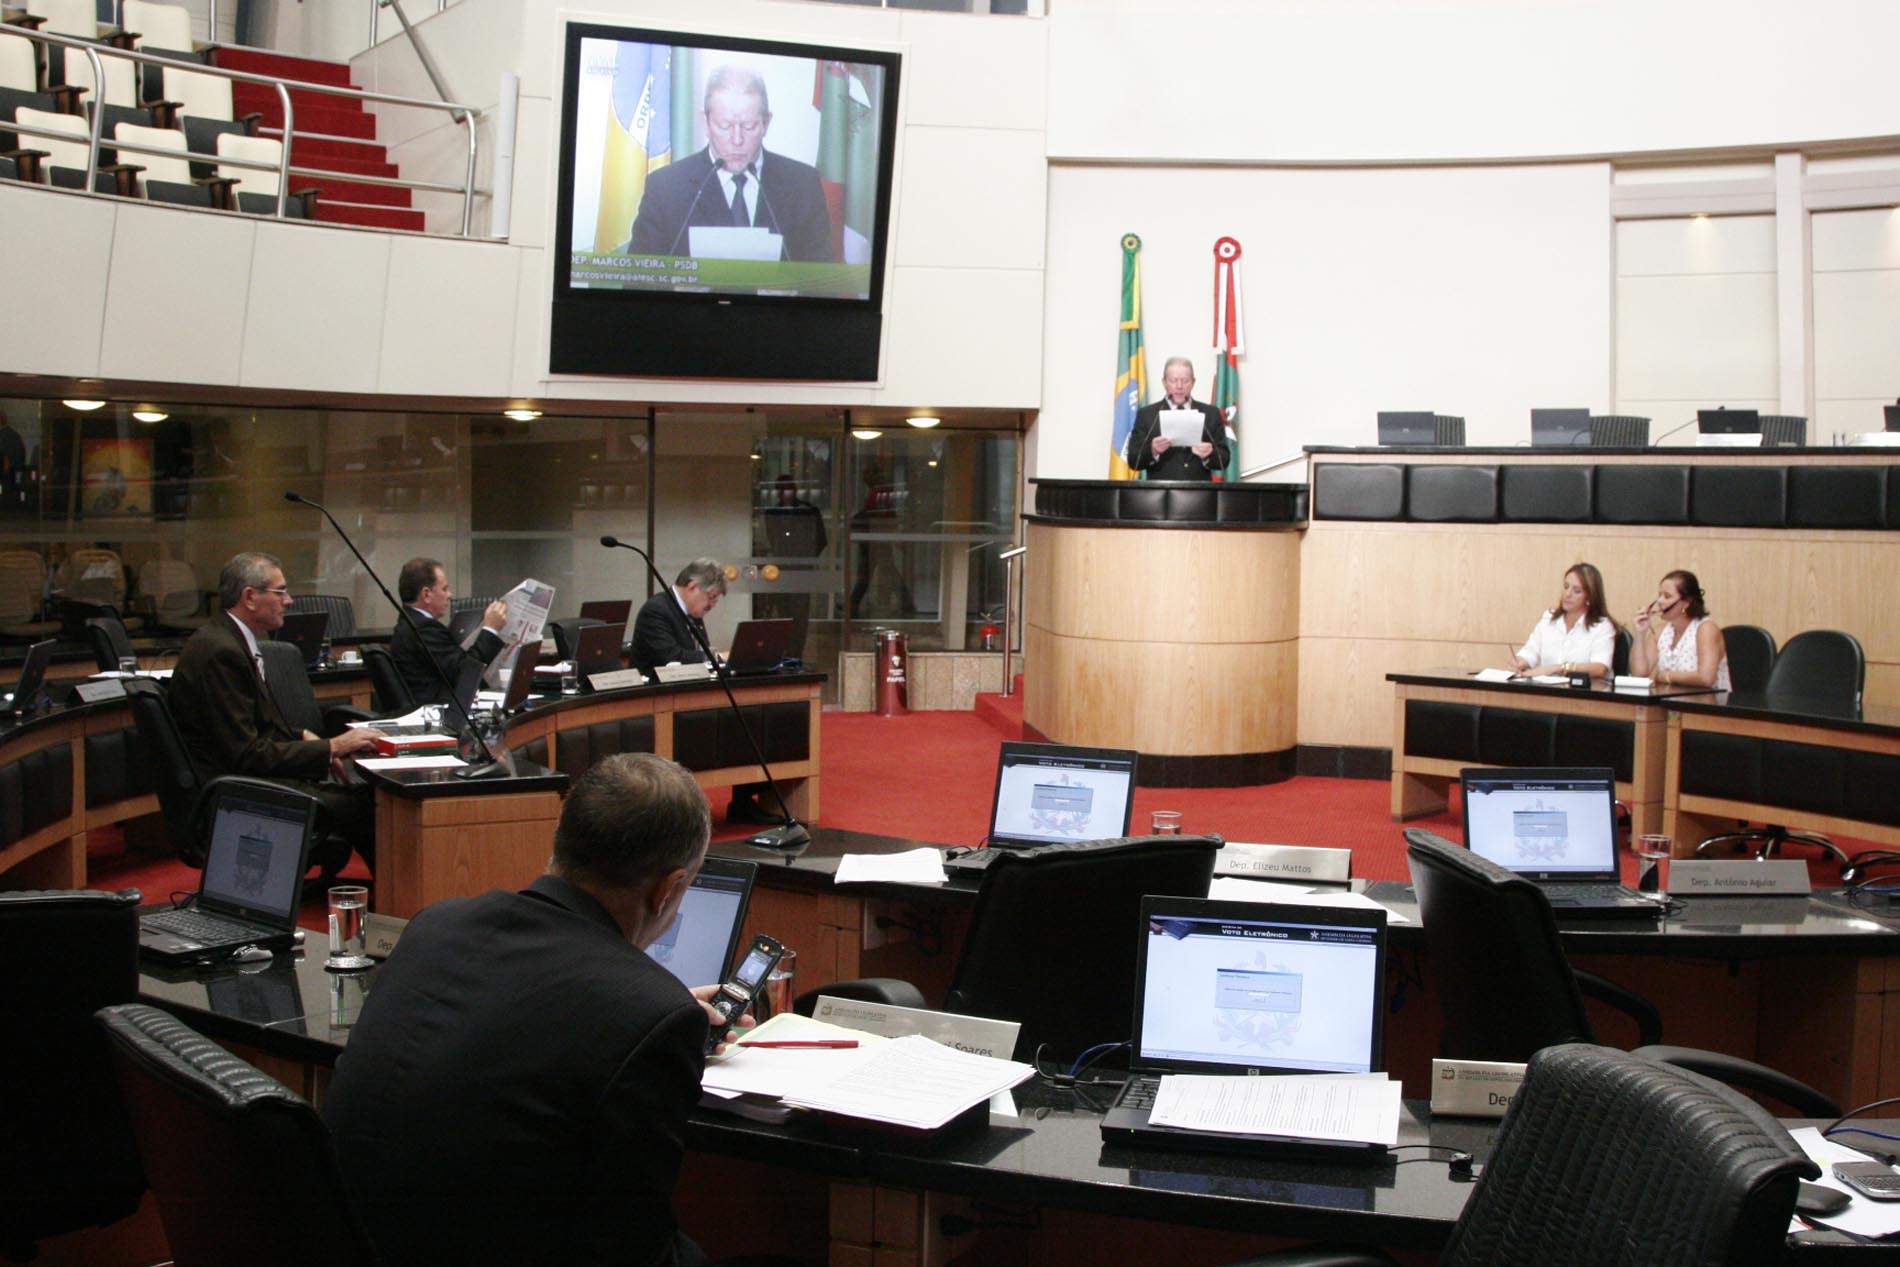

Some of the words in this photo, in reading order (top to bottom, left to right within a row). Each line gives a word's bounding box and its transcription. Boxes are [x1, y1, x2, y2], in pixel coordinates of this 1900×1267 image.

[592, 257, 632, 267] MARCOS
[635, 259, 665, 268] VIEIRA
[674, 260, 698, 270] PSDB
[1229, 860, 1250, 871] Dep.
[1253, 861, 1280, 871] Elizeu
[1281, 863, 1312, 874] Mattos
